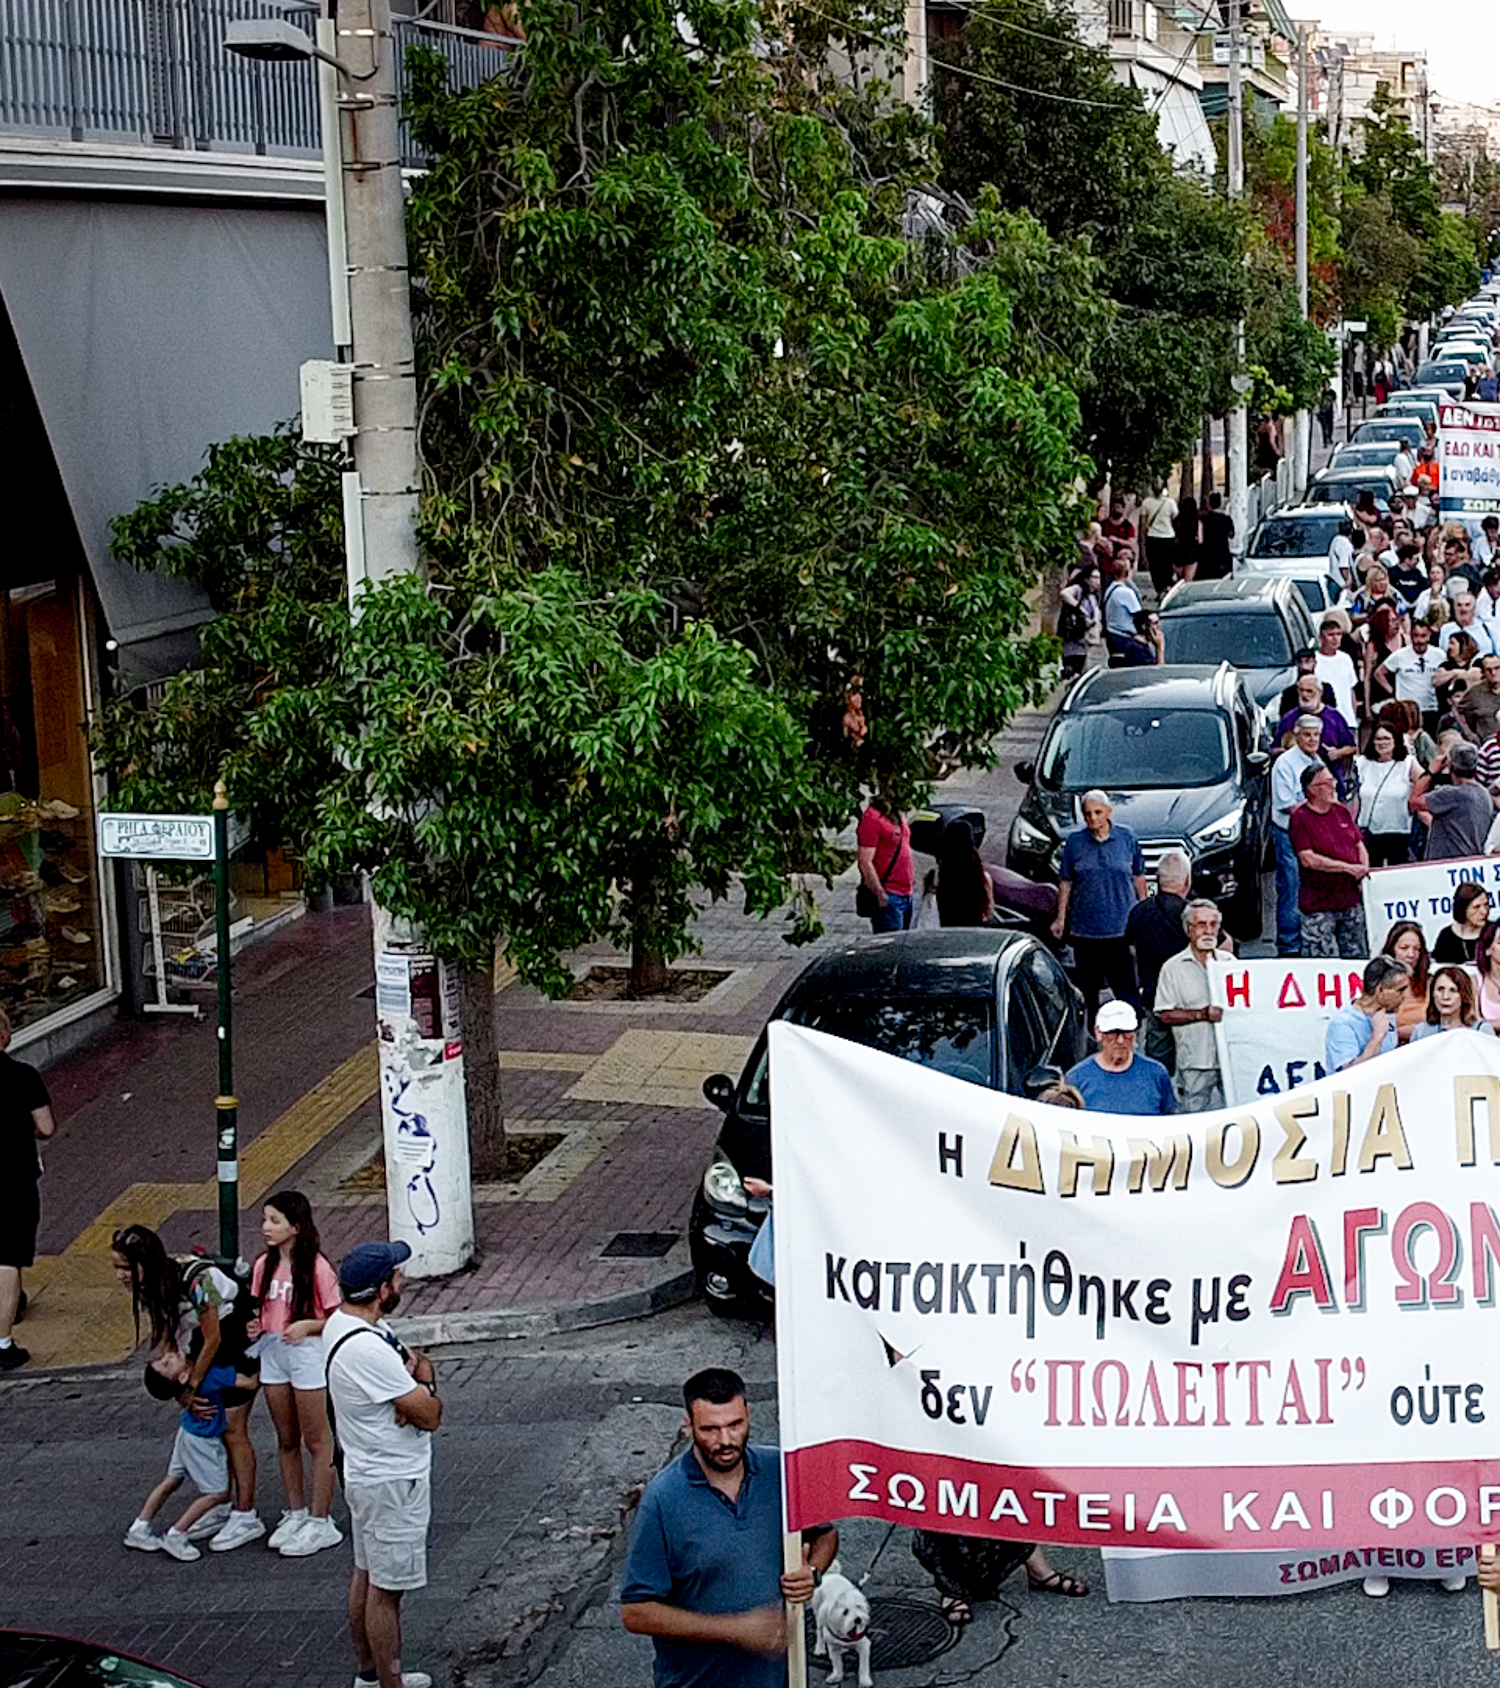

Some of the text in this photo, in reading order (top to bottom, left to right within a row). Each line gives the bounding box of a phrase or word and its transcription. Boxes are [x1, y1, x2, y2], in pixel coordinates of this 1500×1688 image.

[1443, 408, 1474, 426] ΔΕΝ
[1445, 442, 1469, 456] ΕΔΩ
[1473, 443, 1494, 458] ΚΑΙ
[1384, 901, 1419, 920] ΤΟΥ
[1428, 897, 1452, 916] ΤΟ
[1226, 970, 1251, 1008] Η
[939, 1132, 963, 1177] Η
[988, 1082, 1414, 1198] ΔΗΜΟΣΙΑ
[824, 1241, 1172, 1340] κατακτήθηκε
[1190, 1273, 1253, 1346] με
[920, 1369, 994, 1426] δεν
[1390, 1364, 1485, 1426] ούτε
[847, 1463, 1188, 1532] ΣΩΜΑΤΕΙΑ
[1222, 1490, 1333, 1532] ΚΑΙ
[1278, 1546, 1425, 1585] ΣΩΜΑΤΕΙΟ
